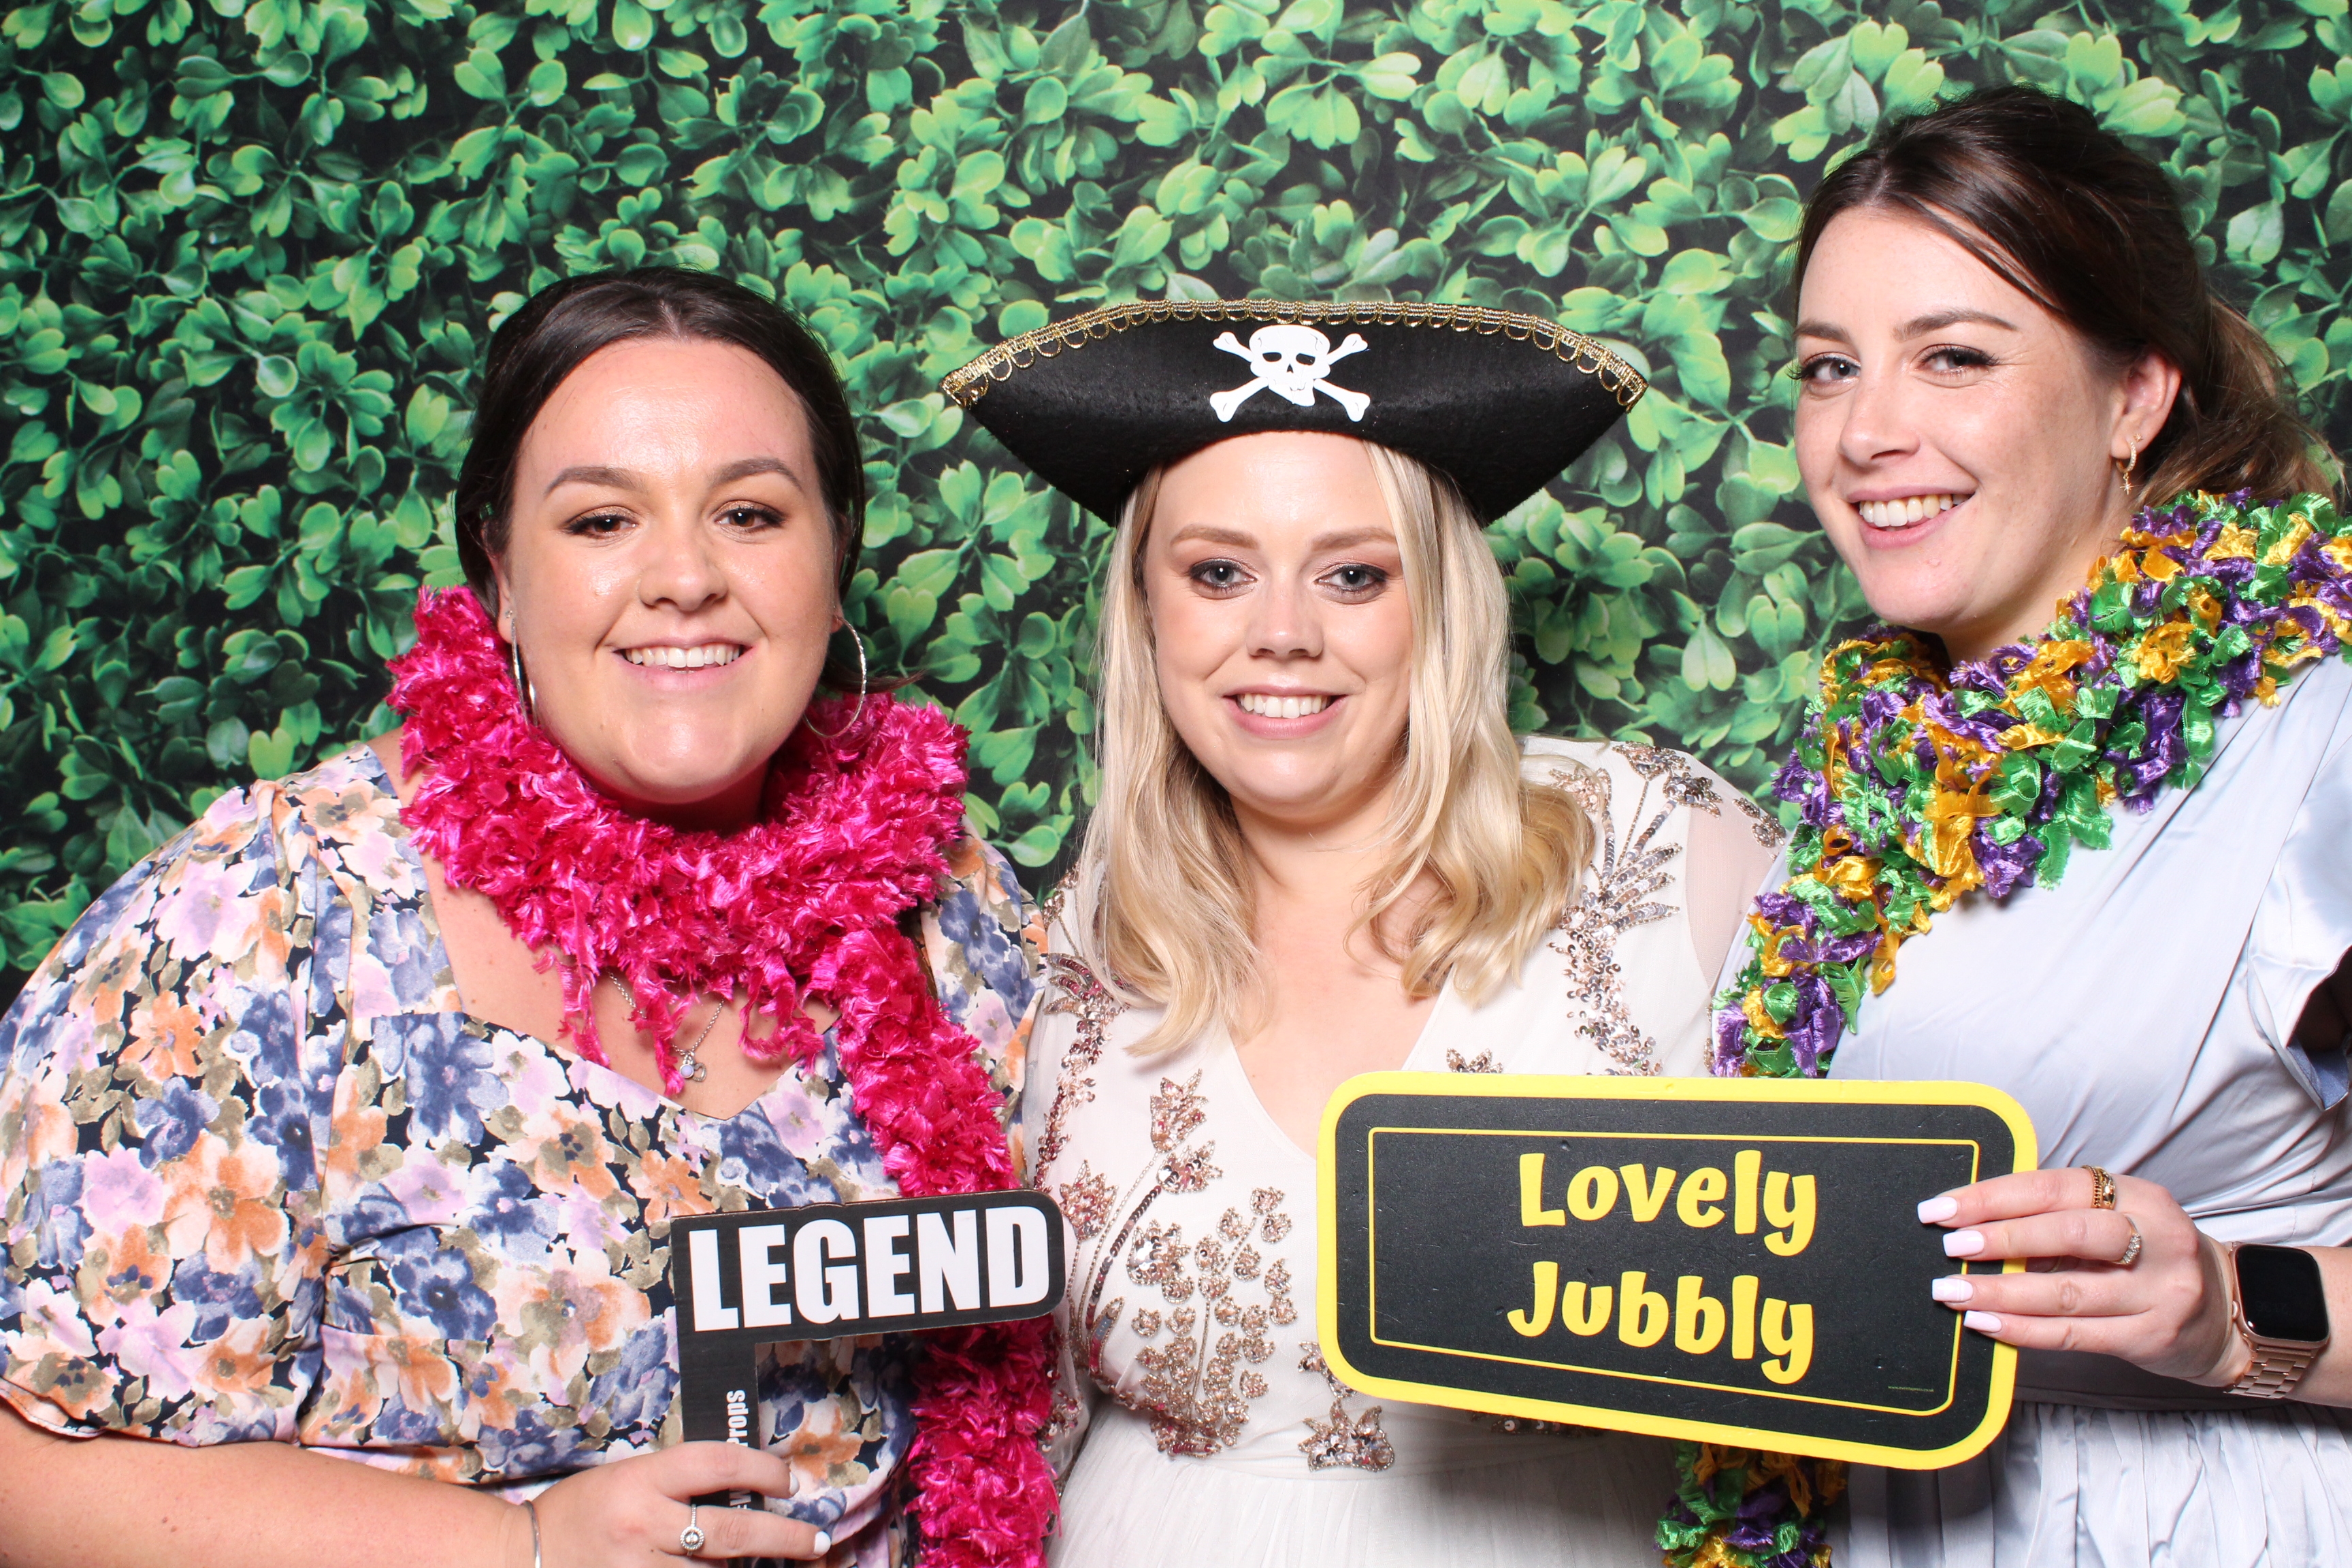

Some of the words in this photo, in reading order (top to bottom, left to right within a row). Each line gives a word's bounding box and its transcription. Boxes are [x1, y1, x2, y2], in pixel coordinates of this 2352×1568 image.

[1519, 1149, 1816, 1257] Lovely
[689, 1206, 1050, 1332] LEGEND
[1507, 1260, 1814, 1385] Jubbly
